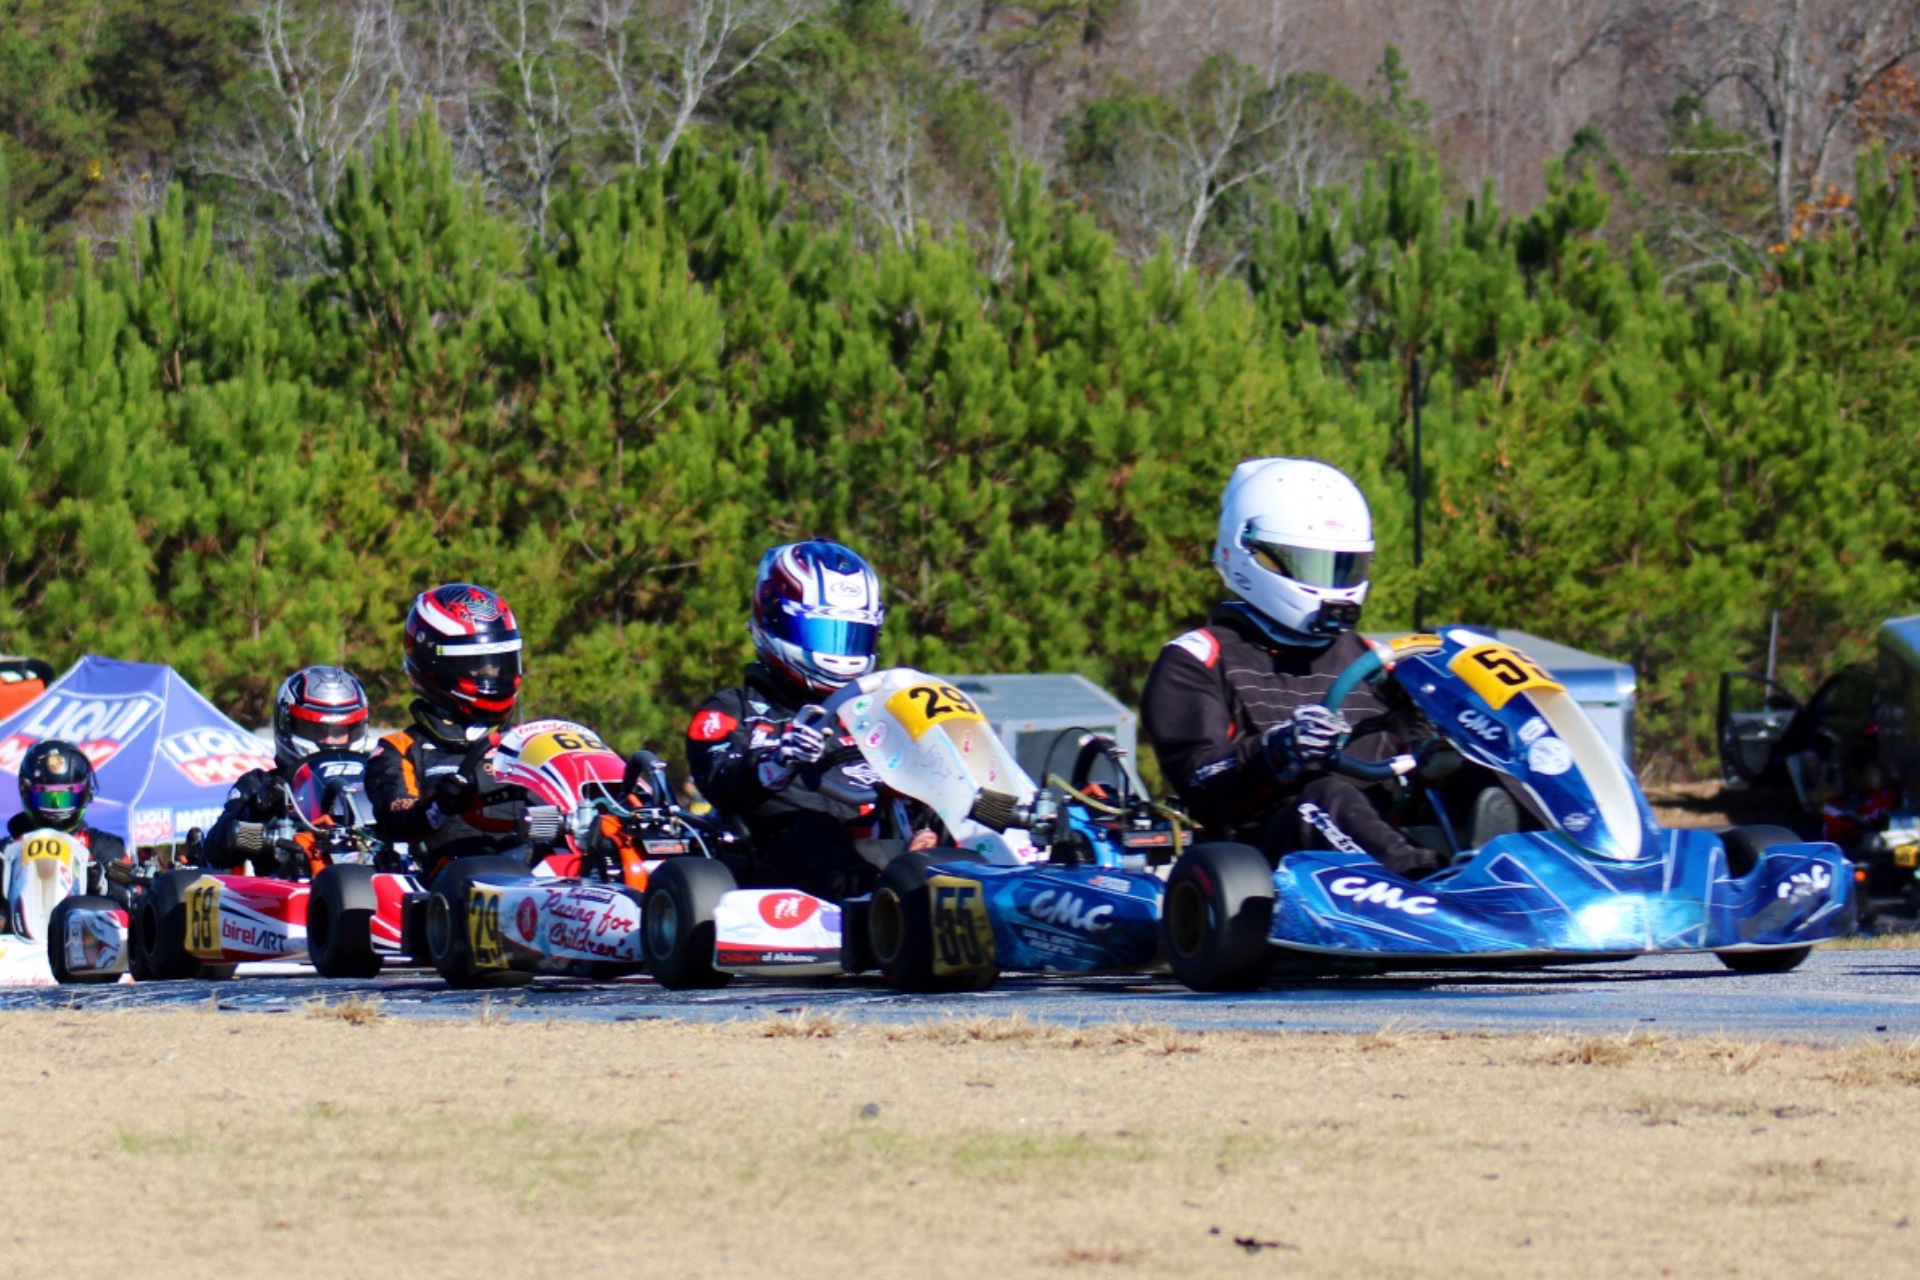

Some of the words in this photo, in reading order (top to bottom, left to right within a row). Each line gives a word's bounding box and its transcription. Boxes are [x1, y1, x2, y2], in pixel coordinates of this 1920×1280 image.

[21, 696, 151, 743] LIQUI
[909, 686, 977, 719] 29
[1457, 709, 1504, 740] CMC
[28, 839, 62, 857] 00
[541, 889, 597, 933] Racing
[596, 904, 634, 936] for
[1029, 890, 1114, 931] CMC
[1330, 877, 1439, 915] CMC
